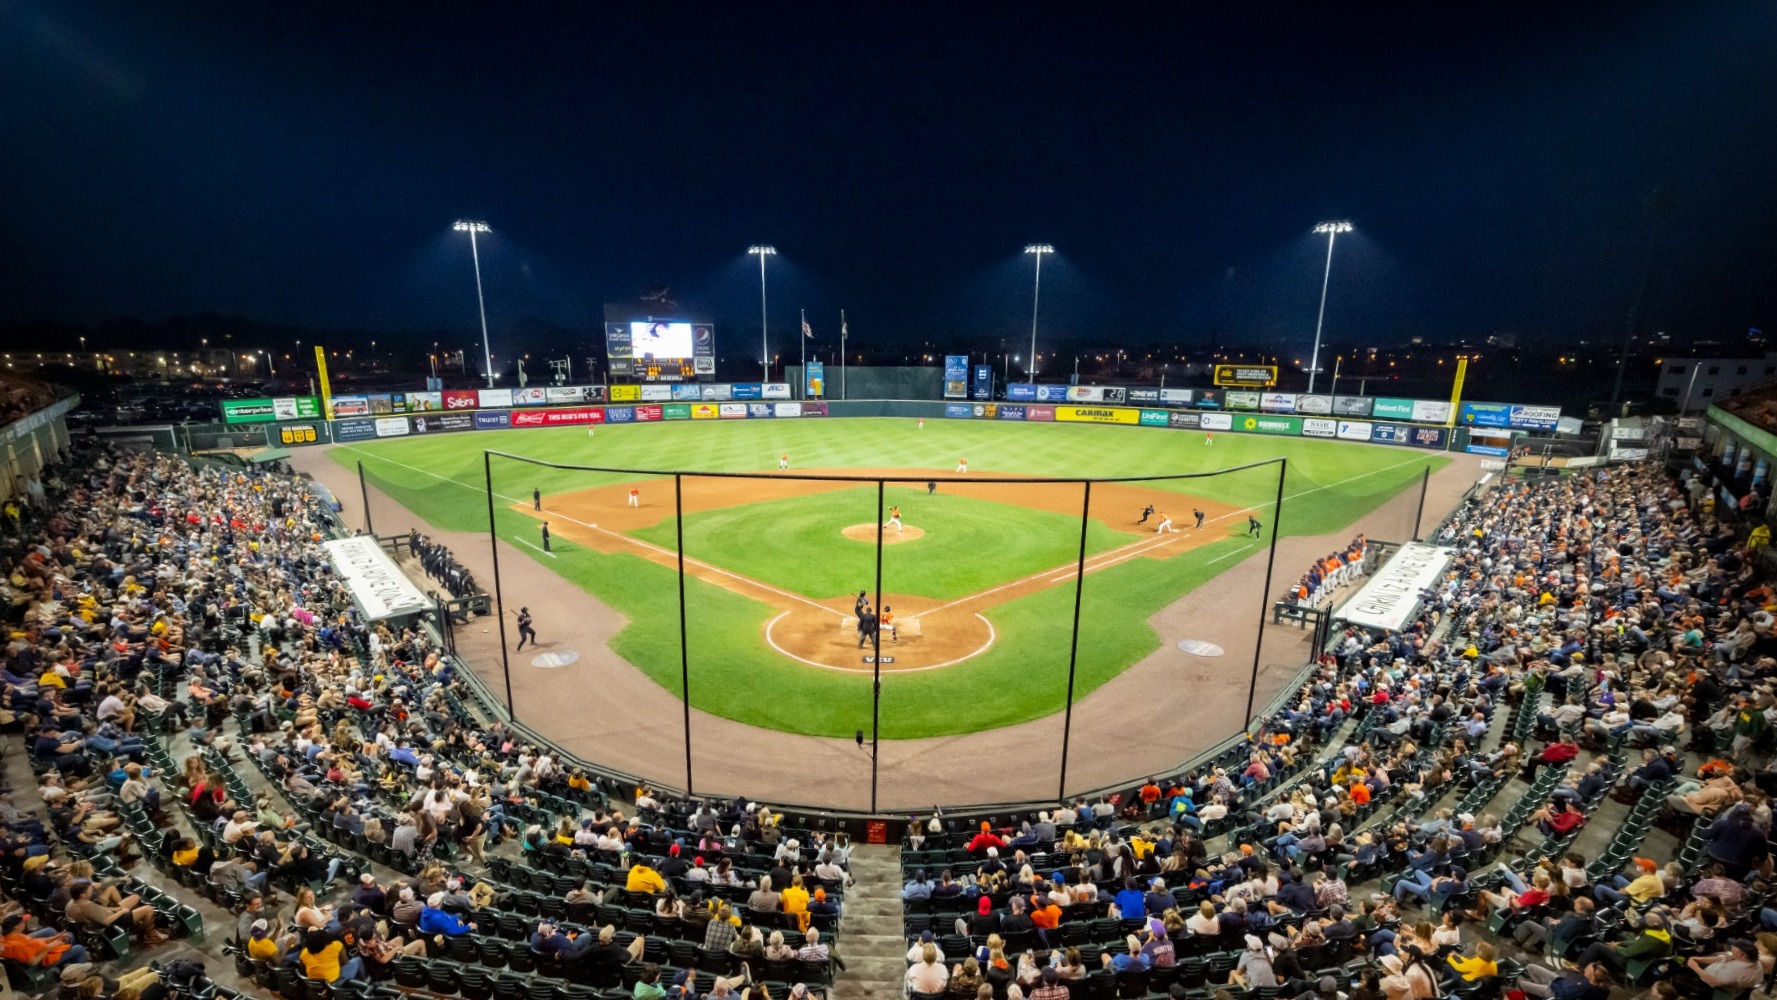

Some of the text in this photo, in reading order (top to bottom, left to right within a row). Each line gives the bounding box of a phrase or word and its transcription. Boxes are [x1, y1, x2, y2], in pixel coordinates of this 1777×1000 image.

[447, 397, 475, 408] Sabra
[227, 406, 273, 416] enterprise
[1375, 404, 1398, 413] Patient
[1398, 405, 1411, 413] First
[1142, 411, 1168, 421] UniFirst
[1523, 411, 1557, 419] ROOFING
[1311, 420, 1329, 428] NASH
